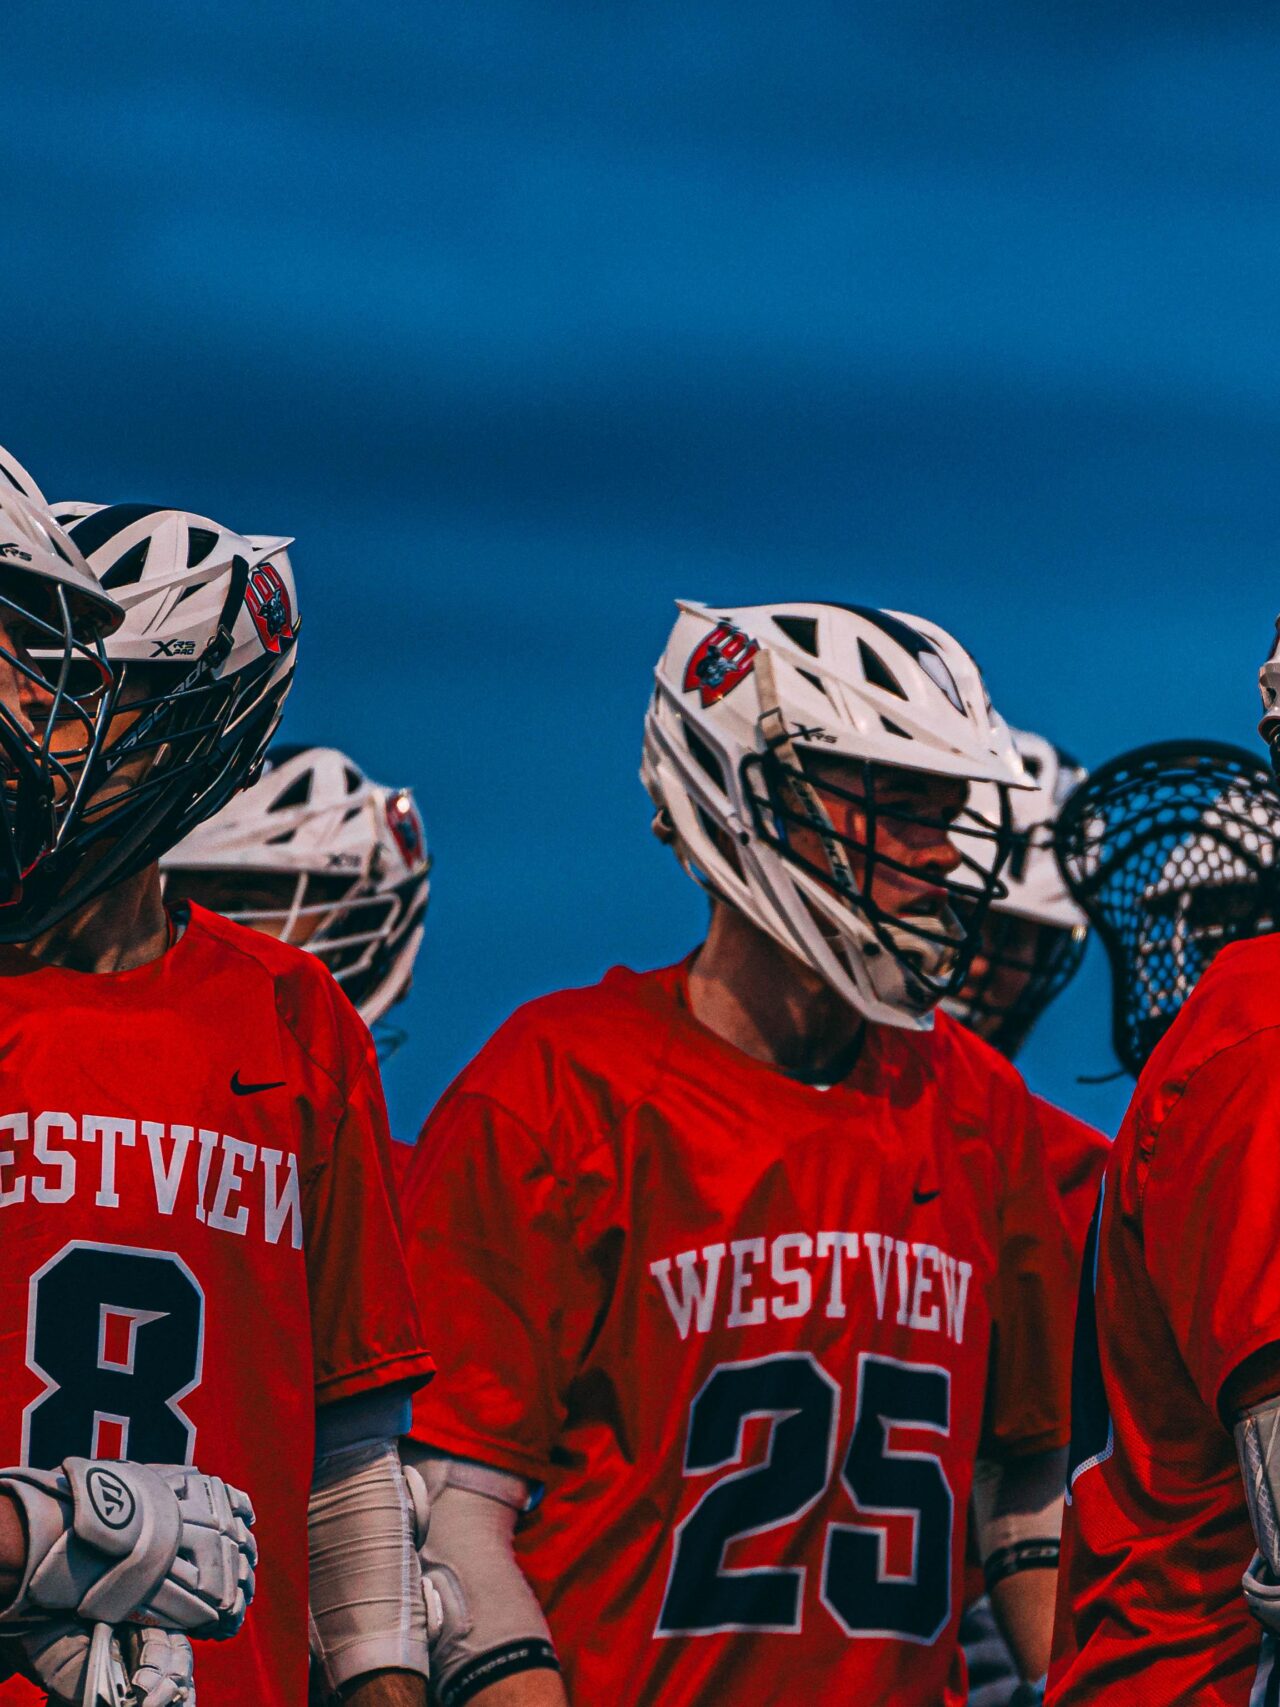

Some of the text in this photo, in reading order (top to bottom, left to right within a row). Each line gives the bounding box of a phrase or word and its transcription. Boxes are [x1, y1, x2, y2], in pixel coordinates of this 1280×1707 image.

[150, 639, 196, 657] XRS
[790, 722, 838, 743] XRS
[650, 1230, 973, 1345] WESTVIEW
[20, 1239, 206, 1467] 8
[652, 1350, 955, 1646] 25
